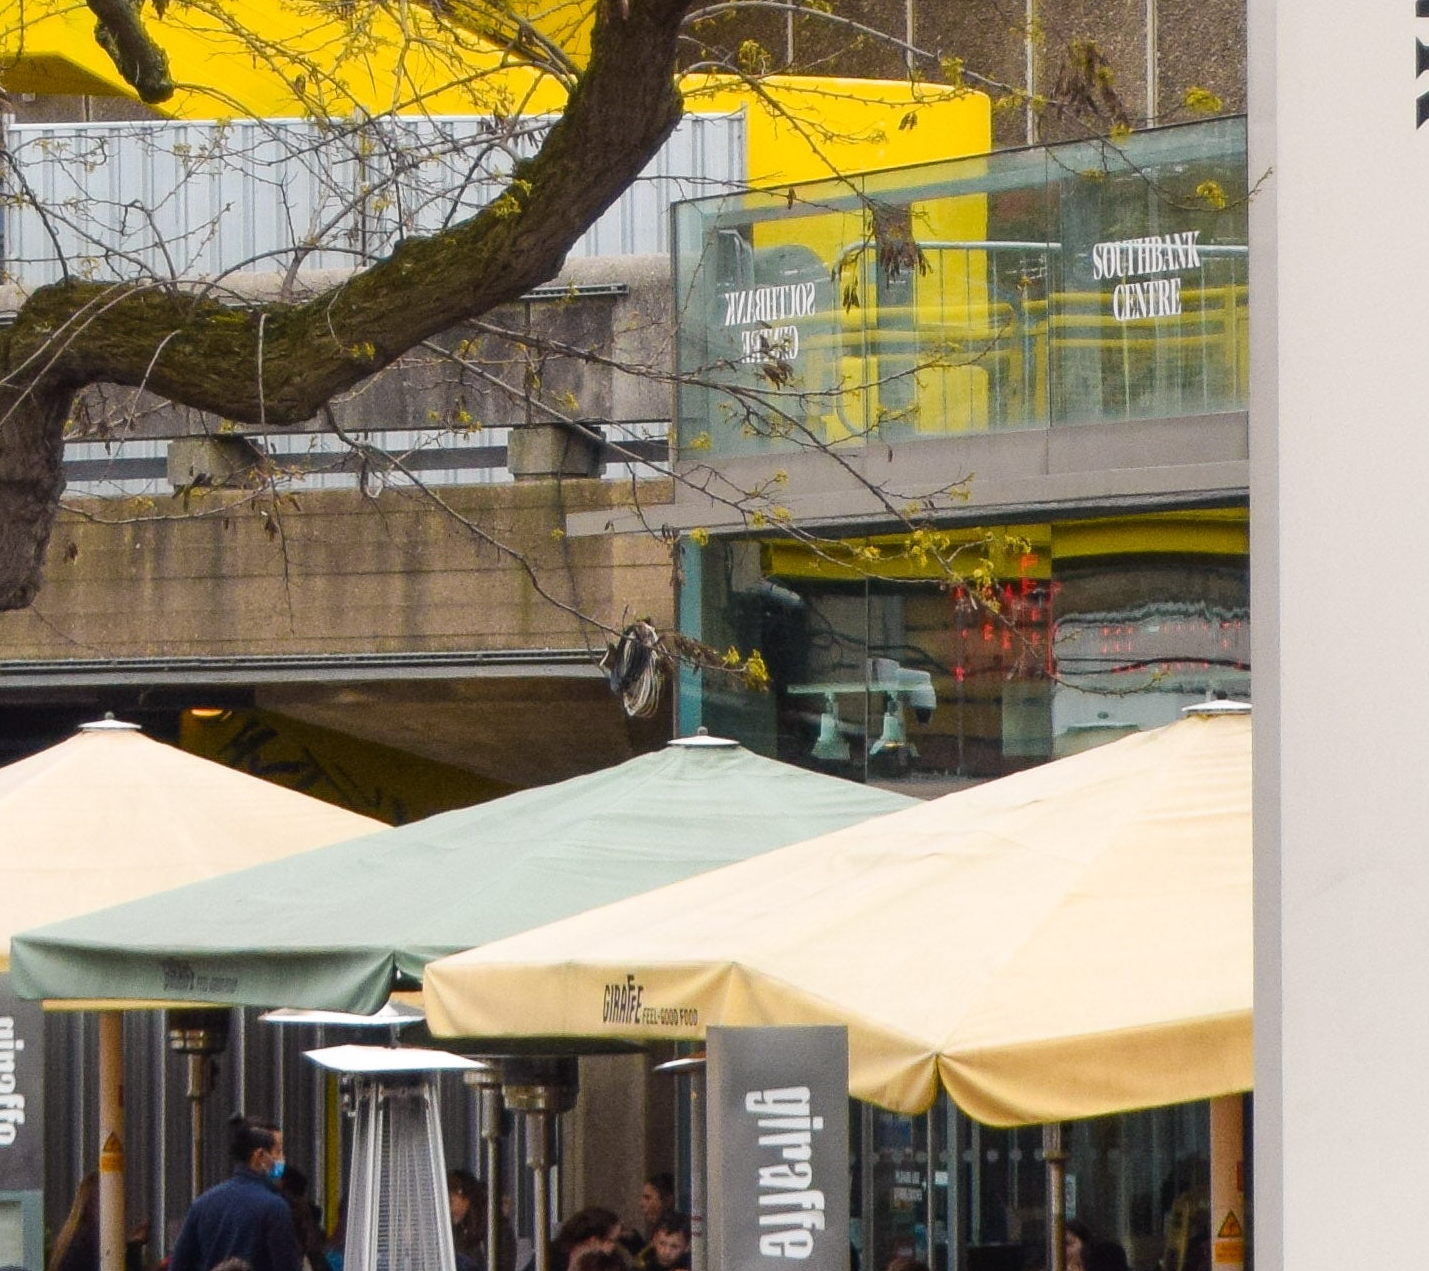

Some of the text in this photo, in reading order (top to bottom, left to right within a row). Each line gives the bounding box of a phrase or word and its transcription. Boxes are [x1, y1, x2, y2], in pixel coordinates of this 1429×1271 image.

[1092, 230, 1201, 280] SOUTHBANK
[1113, 277, 1182, 321] CENTRE
[602, 974, 644, 1024] GIRAFFE
[680, 1008, 699, 1026] FOOD
[745, 1086, 825, 1259] giraffe
